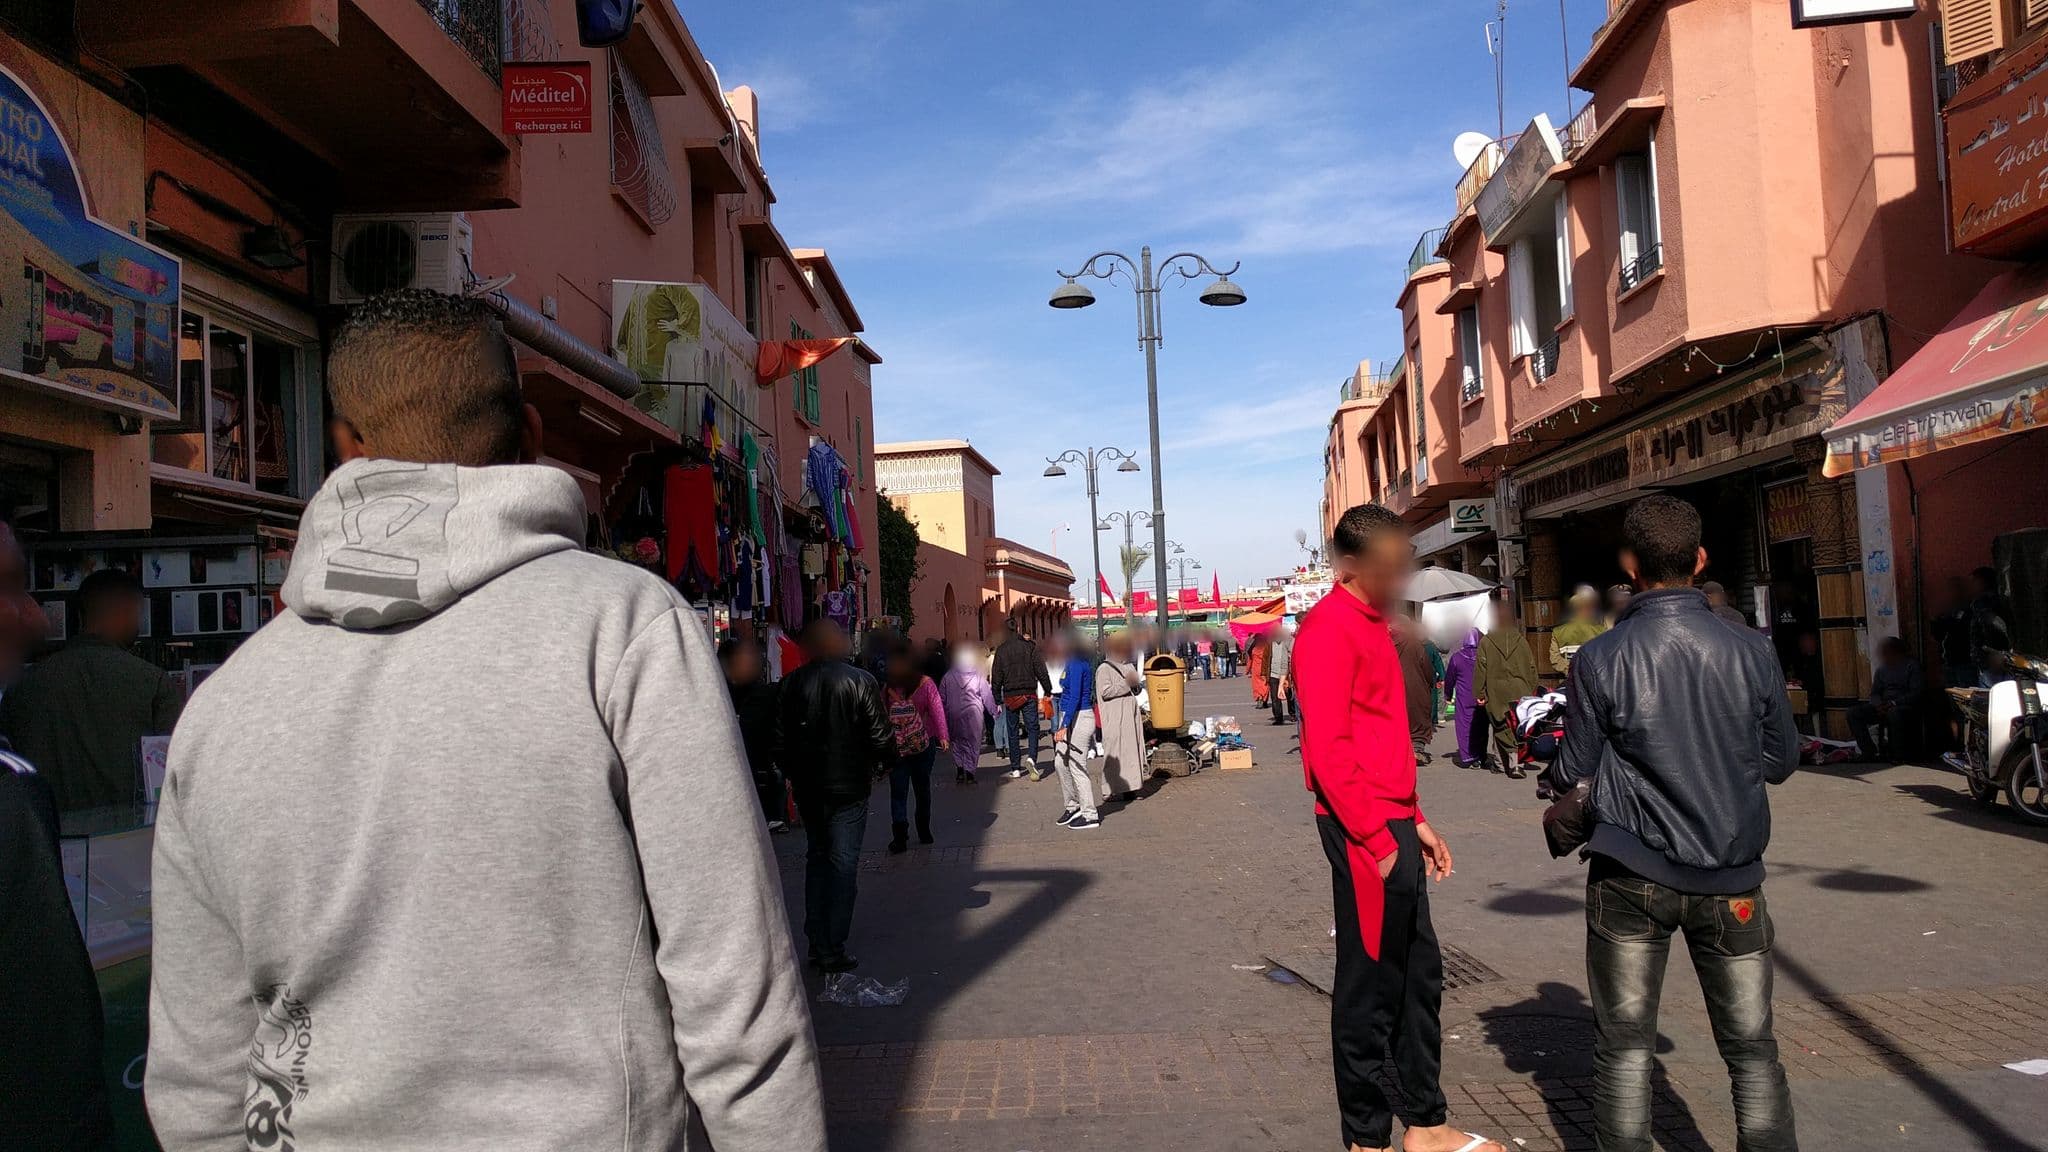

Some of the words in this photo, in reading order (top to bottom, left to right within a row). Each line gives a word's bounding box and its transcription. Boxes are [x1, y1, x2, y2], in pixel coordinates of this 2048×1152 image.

[510, 87, 574, 103] Méditel
[515, 121, 568, 132] Rechargez
[1959, 179, 2030, 239] Central
